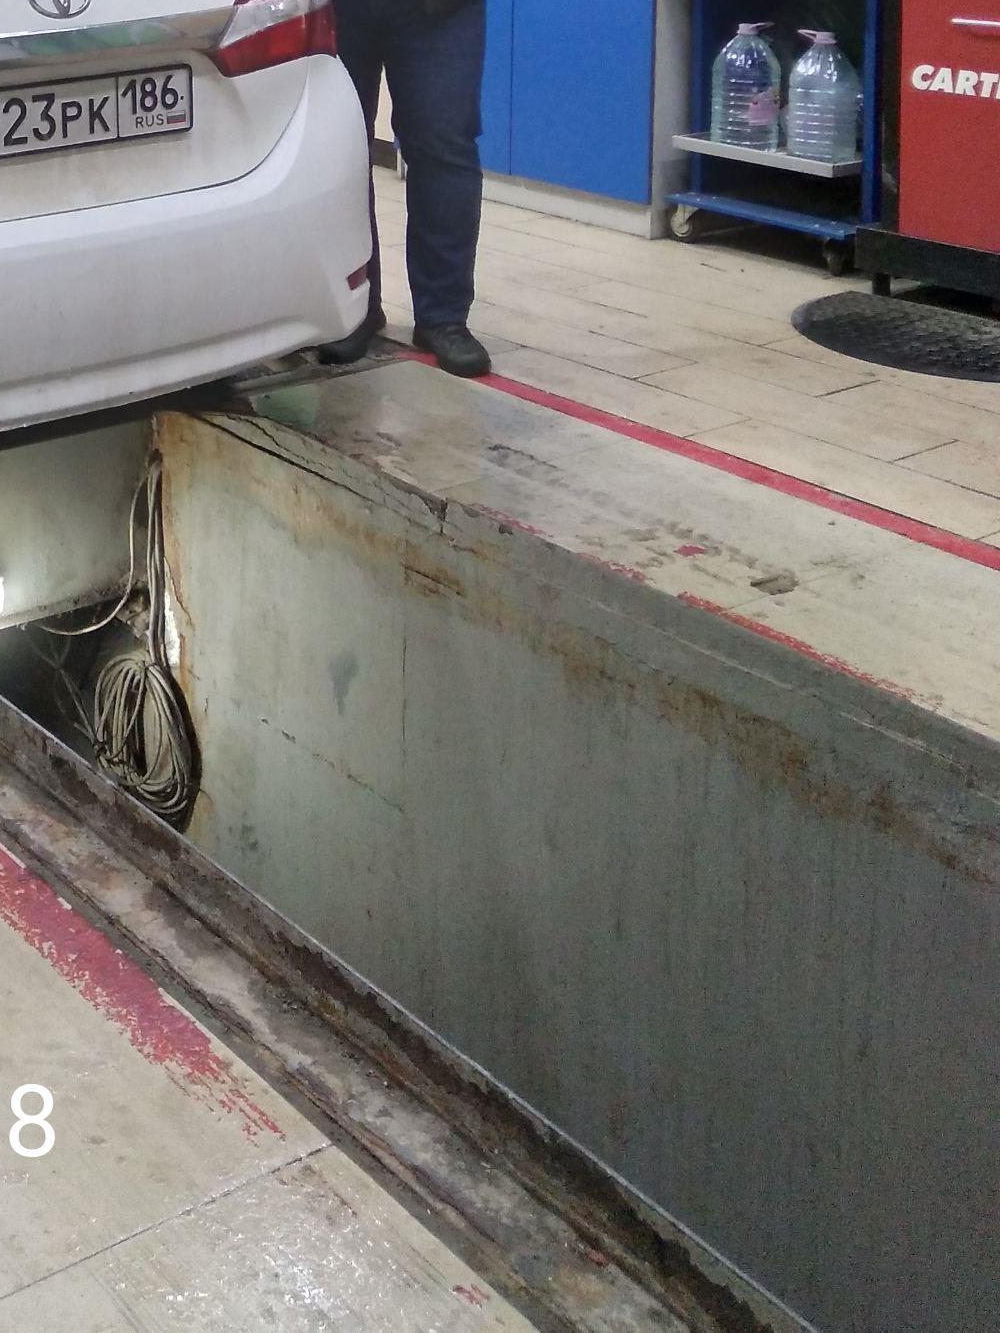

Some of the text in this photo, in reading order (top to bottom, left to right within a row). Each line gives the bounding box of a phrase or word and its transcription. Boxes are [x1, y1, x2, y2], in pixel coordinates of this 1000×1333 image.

[120, 74, 179, 115] 186
[912, 64, 1000, 99] CART
[135, 113, 164, 129] RUS
